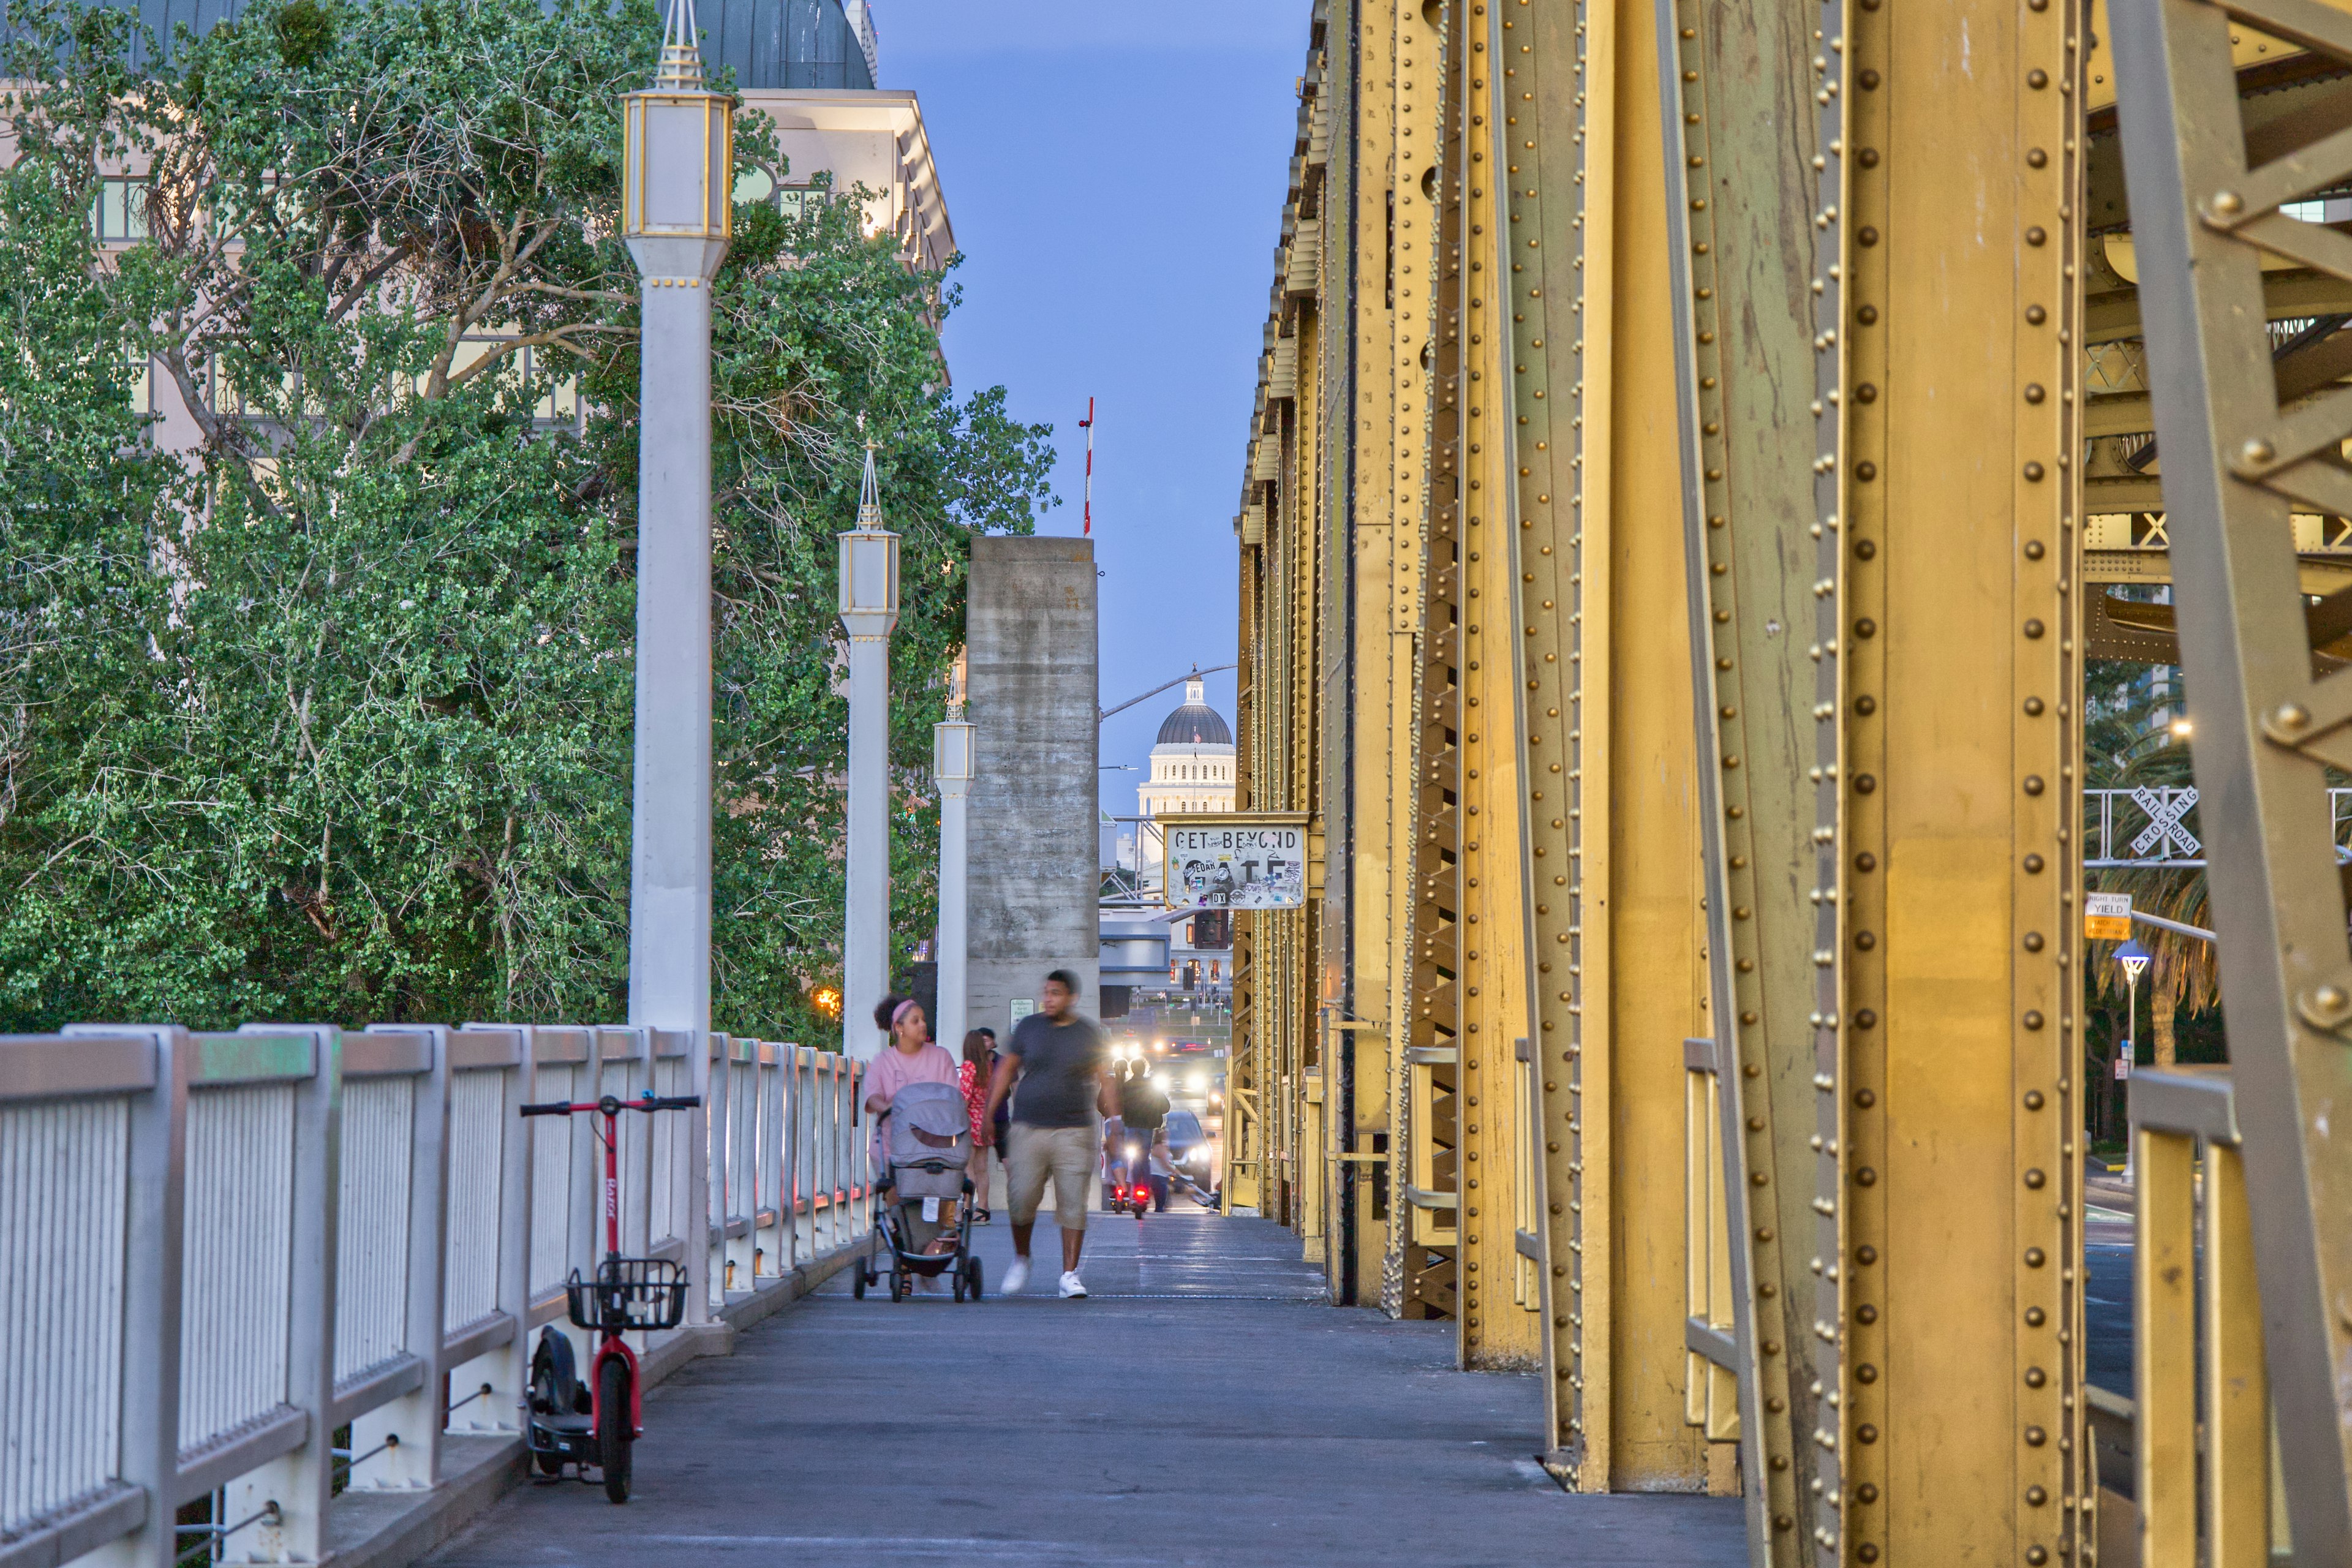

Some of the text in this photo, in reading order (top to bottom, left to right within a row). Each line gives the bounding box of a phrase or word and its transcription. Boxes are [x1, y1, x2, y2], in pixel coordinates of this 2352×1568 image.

[2135, 789, 2196, 851] RAIL ROAD
[2135, 791, 2196, 851] CROSSING
[1175, 832, 1208, 849] GET
[1223, 831, 1295, 849] BEYOND
[2095, 905, 2123, 913] YIELD
